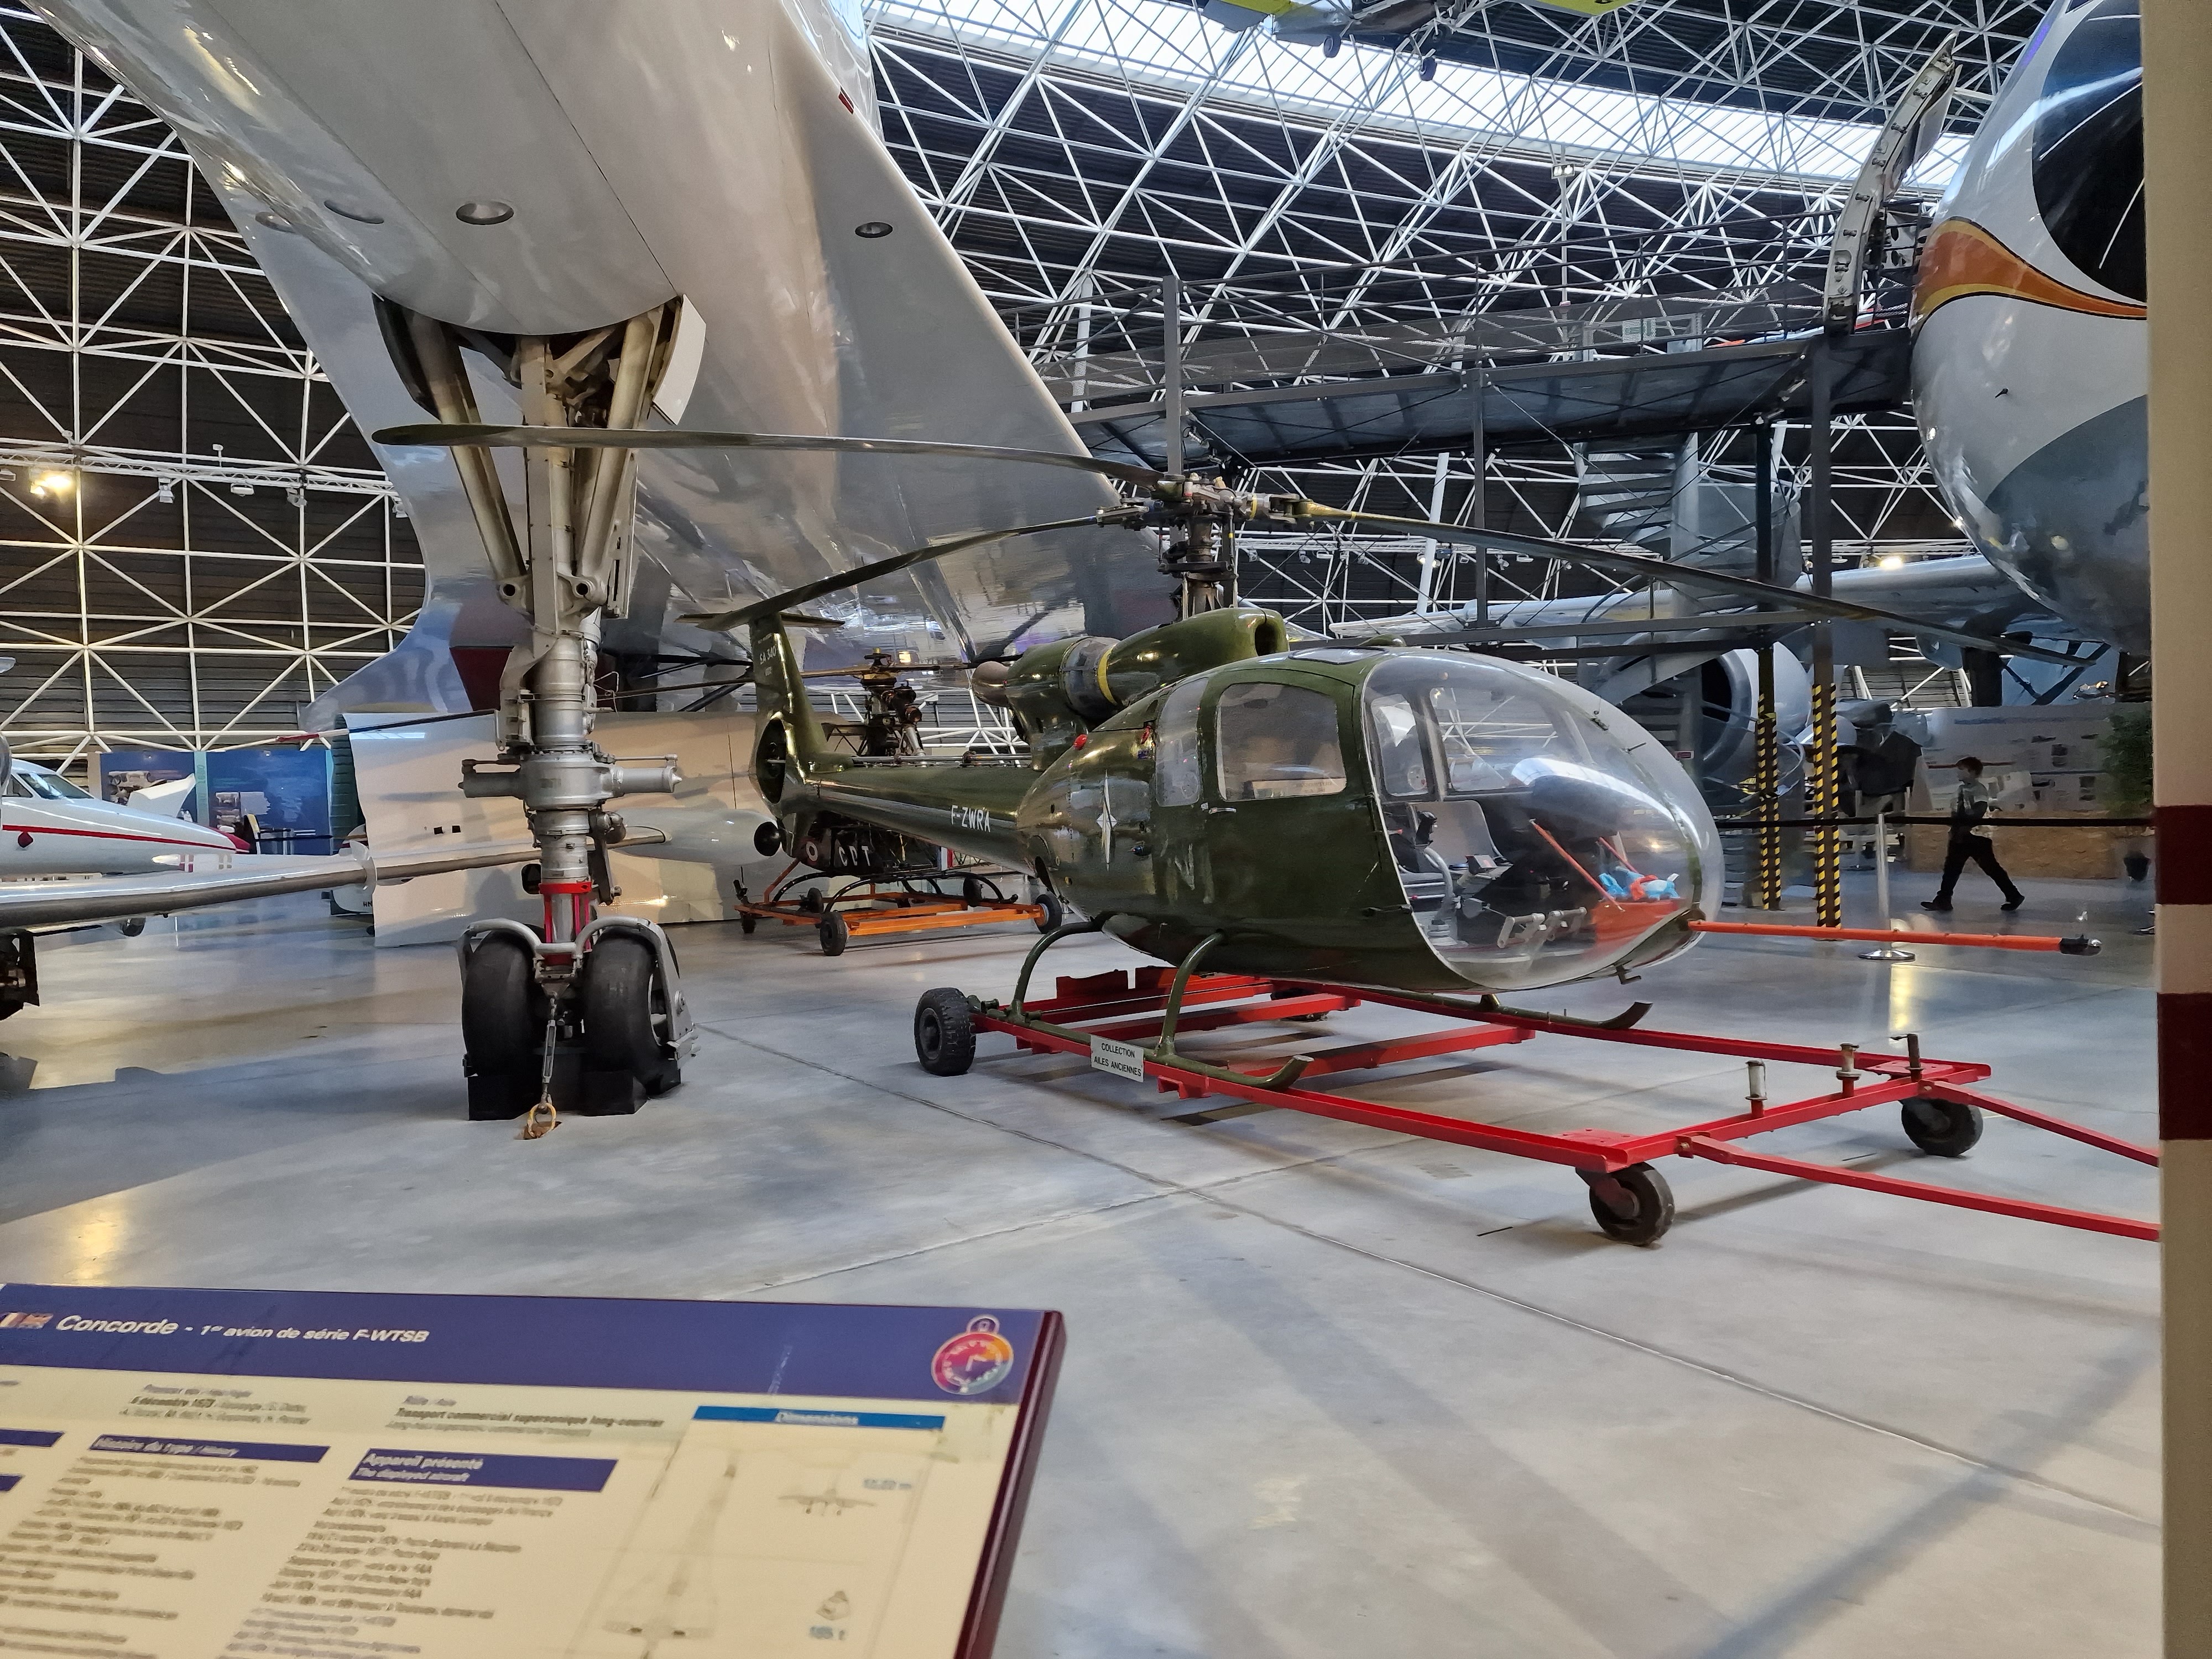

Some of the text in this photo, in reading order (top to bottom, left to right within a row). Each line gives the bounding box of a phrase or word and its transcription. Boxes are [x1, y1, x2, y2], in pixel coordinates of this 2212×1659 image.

[951, 805, 990, 833] F-ZWRA
[1101, 1043, 1135, 1058] COLLECTION
[1094, 1056, 1141, 1077] AILES ANCIENNES
[55, 1314, 180, 1335] Concorde
[223, 1326, 274, 1337] avion
[276, 1327, 301, 1339] de
[302, 1328, 350, 1340] série
[352, 1329, 430, 1343] F-WTSB
